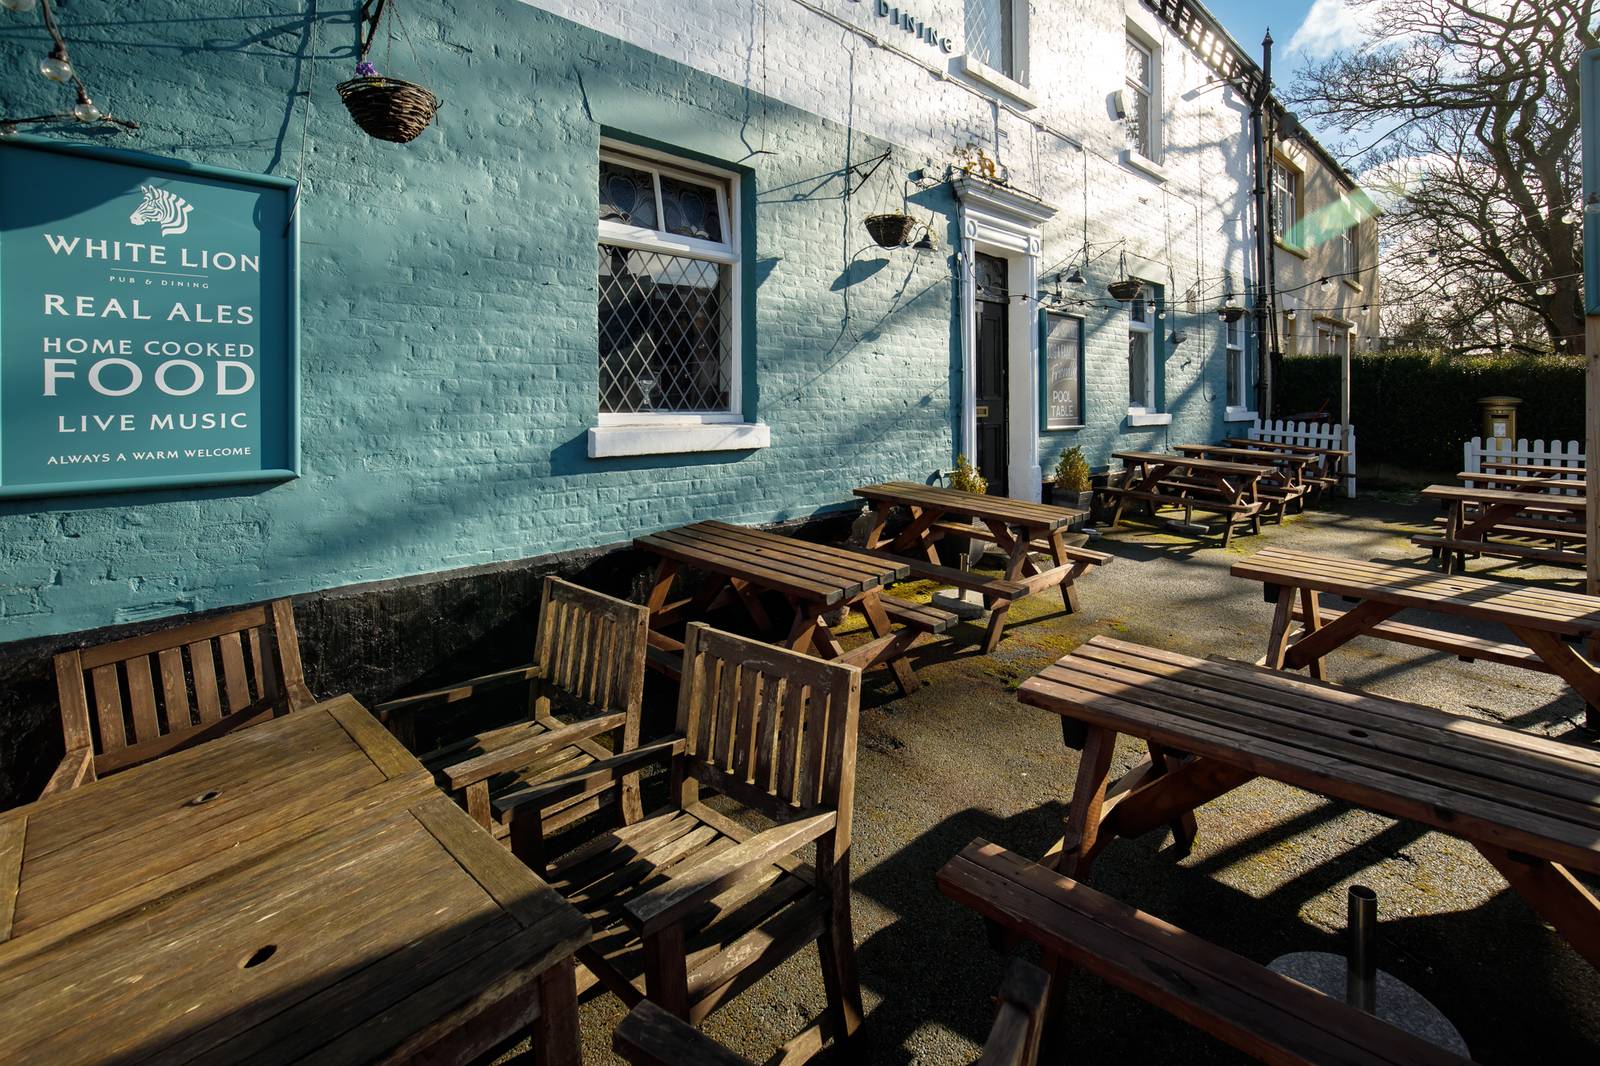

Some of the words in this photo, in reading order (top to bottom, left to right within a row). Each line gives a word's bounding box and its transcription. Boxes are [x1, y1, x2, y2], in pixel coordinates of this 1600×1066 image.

[876, 0, 952, 53] DINING
[44, 234, 167, 265] WHITE
[181, 248, 259, 272] LION
[161, 280, 209, 289] DINING
[44, 294, 152, 320] REAL
[167, 302, 254, 325] ALES
[43, 337, 133, 354] HOME
[144, 341, 255, 358] COOKED
[42, 358, 256, 397] FOOD
[1052, 390, 1072, 403] POOL
[1050, 405, 1074, 417] TABLE
[58, 415, 136, 433] LIVE
[149, 413, 248, 432] MUSIC
[47, 453, 110, 465] ALWAYS
[116, 453, 126, 462] A
[132, 450, 179, 461] WARM
[184, 447, 252, 458] WELCOME
